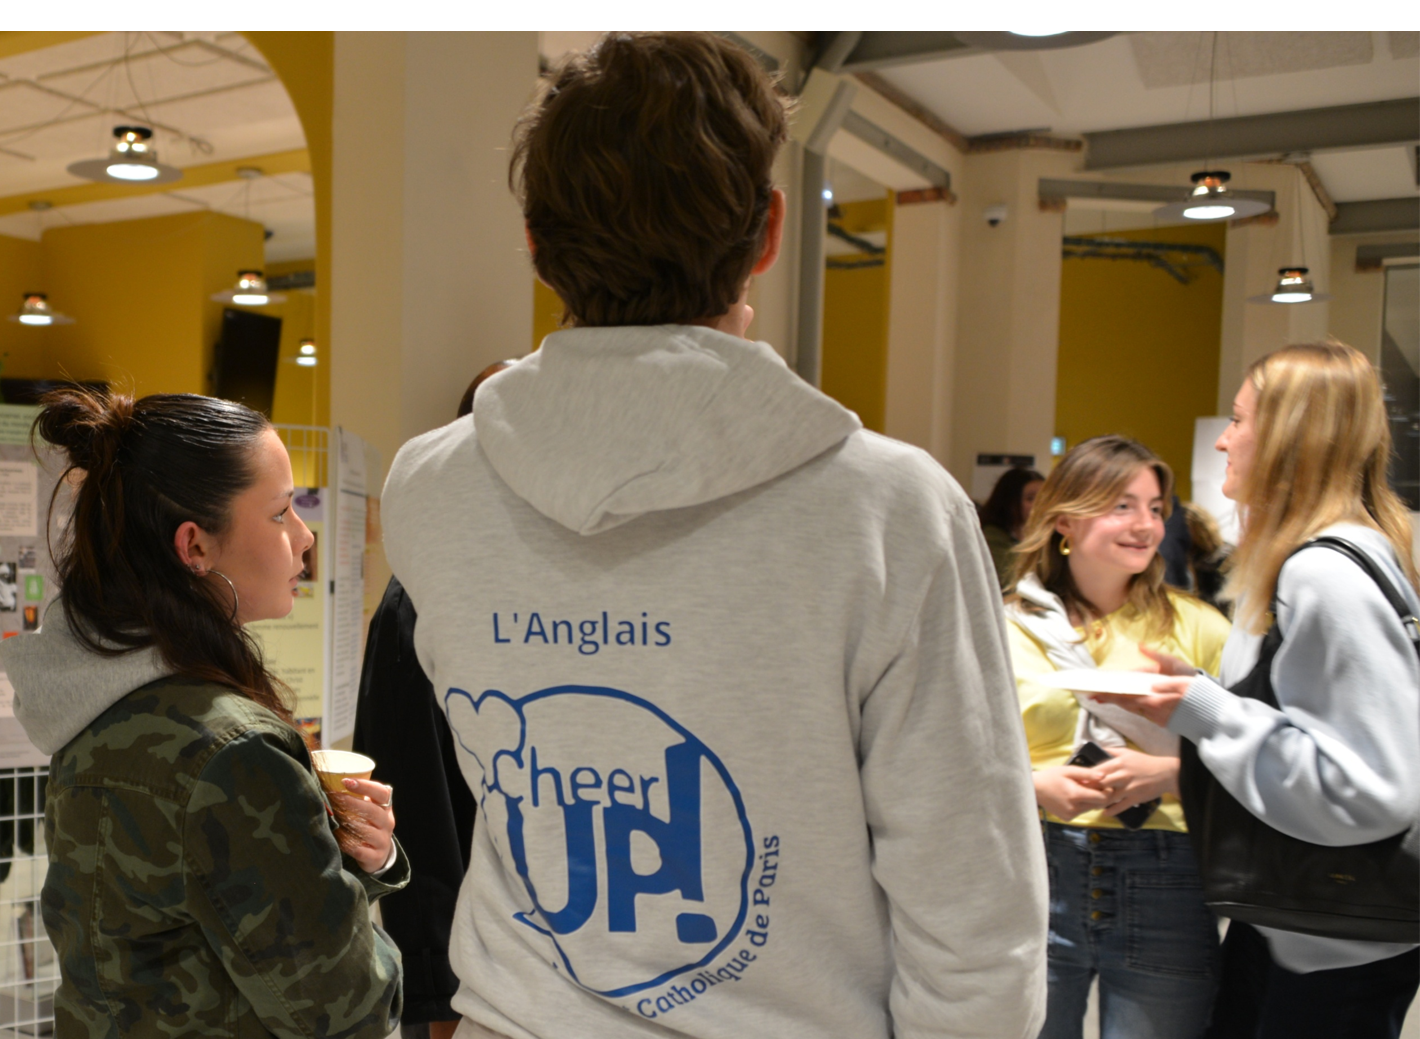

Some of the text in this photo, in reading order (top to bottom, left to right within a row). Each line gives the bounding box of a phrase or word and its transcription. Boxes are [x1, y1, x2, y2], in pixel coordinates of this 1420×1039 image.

[493, 611, 672, 656] L'Anglais
[493, 745, 659, 808] Cheer
[505, 739, 719, 944] UP!
[636, 834, 781, 1020] Catholique de Paris
